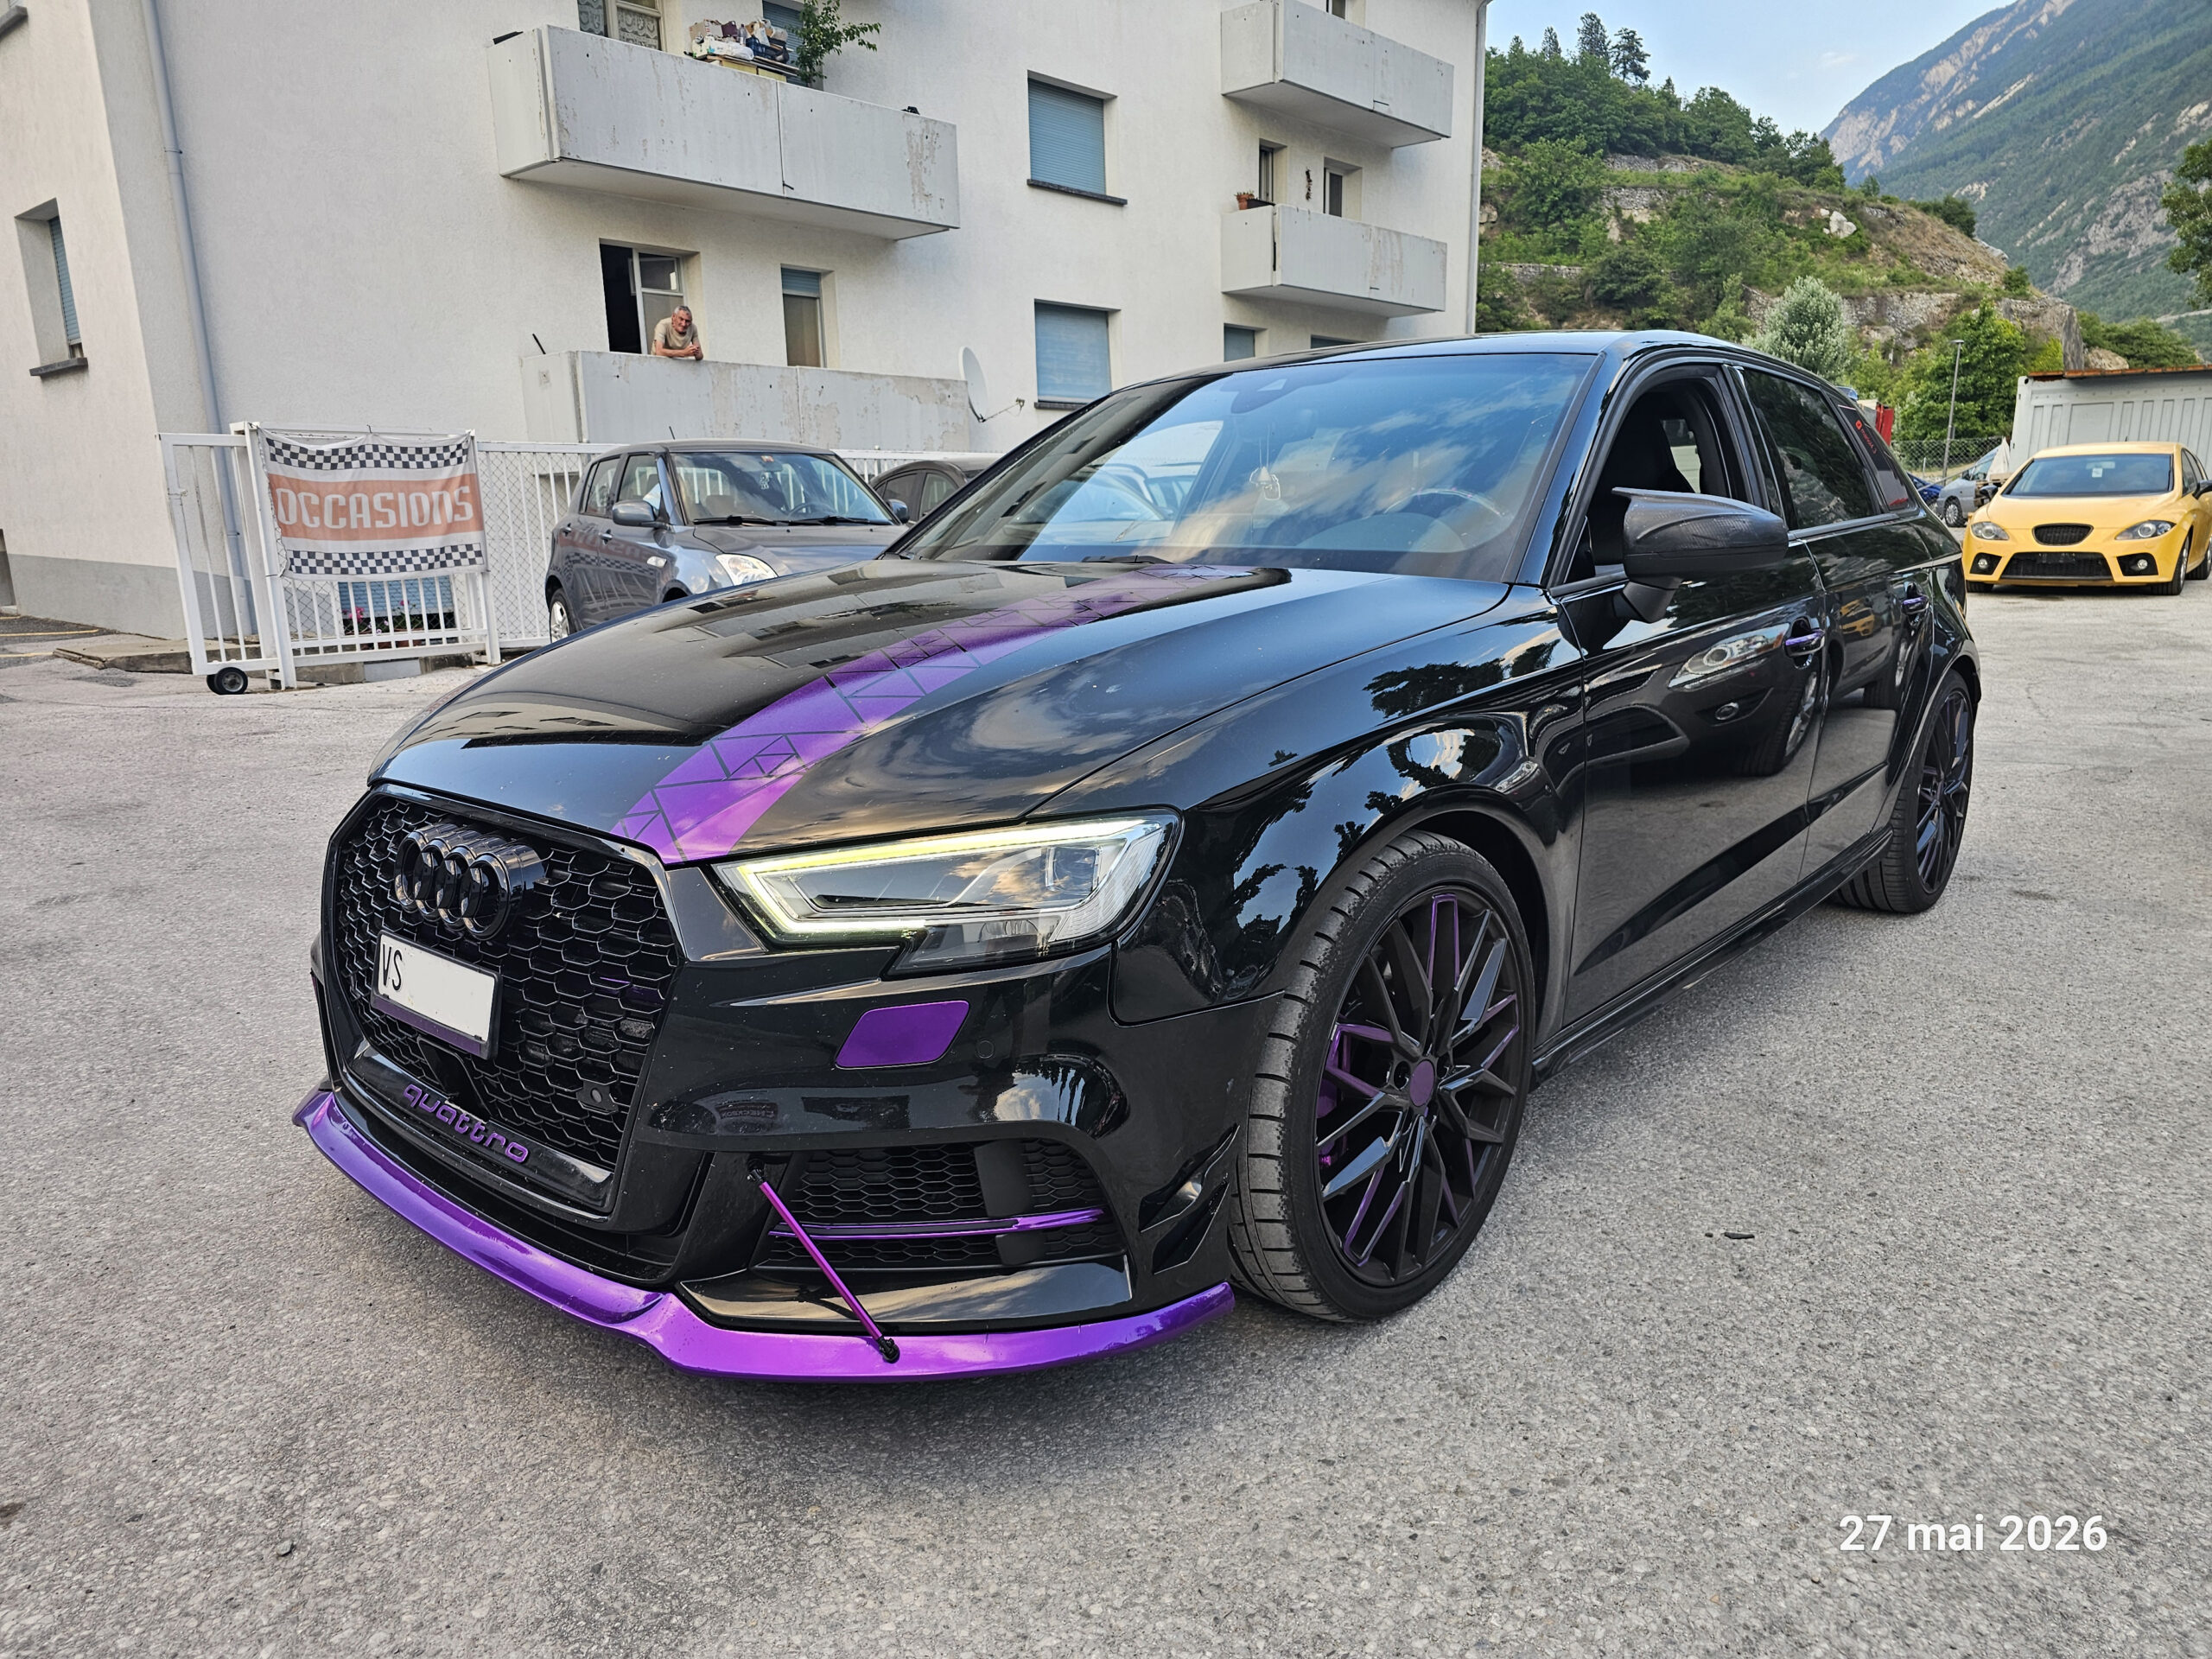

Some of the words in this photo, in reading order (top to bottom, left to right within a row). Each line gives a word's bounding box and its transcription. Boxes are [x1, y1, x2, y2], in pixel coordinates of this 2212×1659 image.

[276, 486, 474, 530] OCCASIONS
[382, 944, 403, 990] VS
[403, 1084, 530, 1164] quattro
